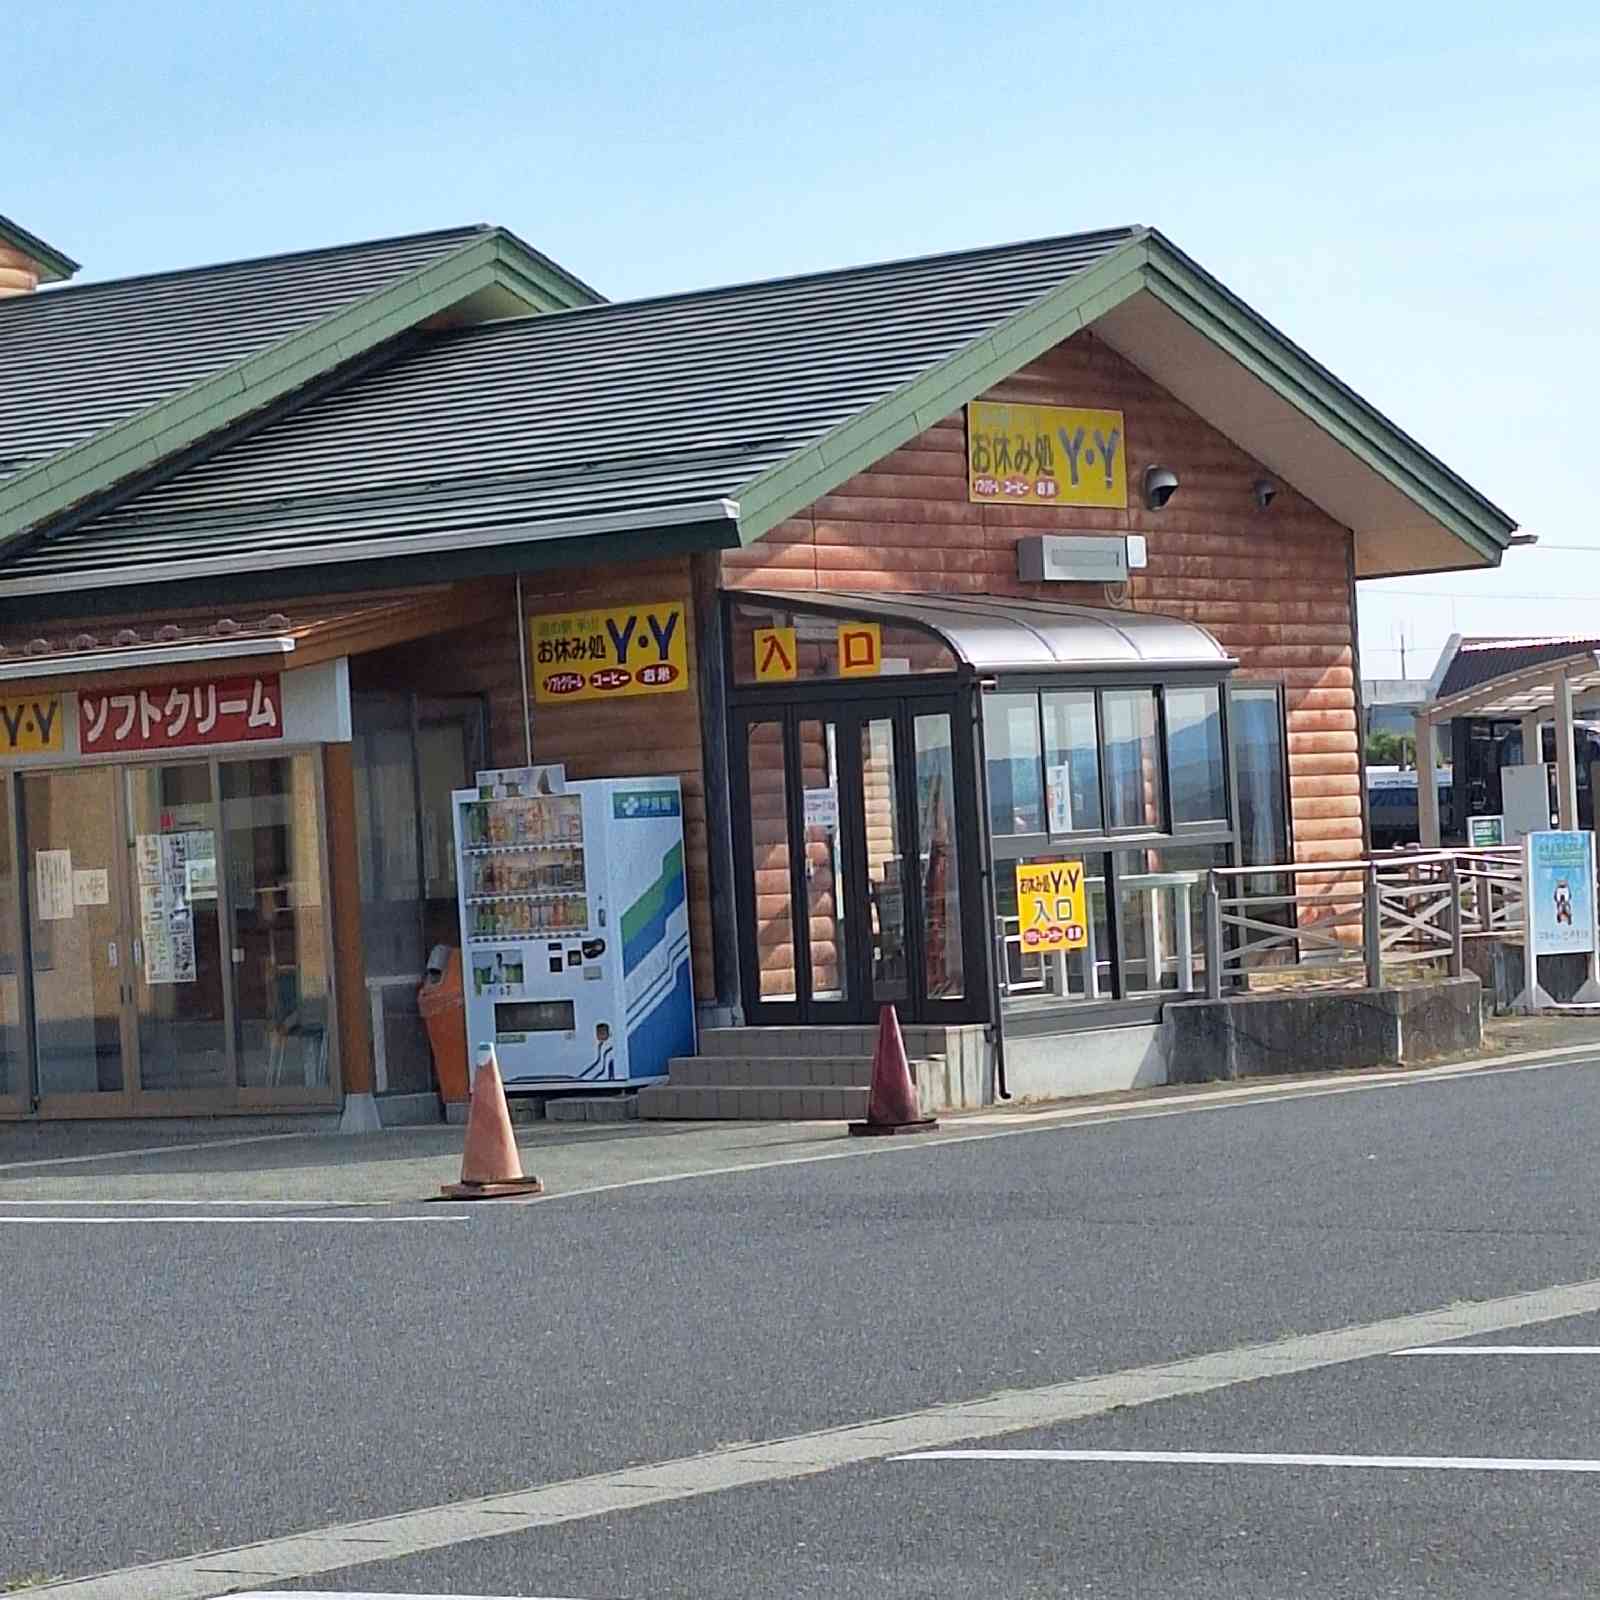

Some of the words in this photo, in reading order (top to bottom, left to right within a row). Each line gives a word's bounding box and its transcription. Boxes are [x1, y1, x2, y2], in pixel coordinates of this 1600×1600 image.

[972, 432, 1055, 475] お休み処
[538, 635, 606, 663] お休み処
[593, 672, 629, 686] コーヒー
[83, 680, 276, 742] ソフトクリーム
[1034, 899, 1072, 923] 入口
